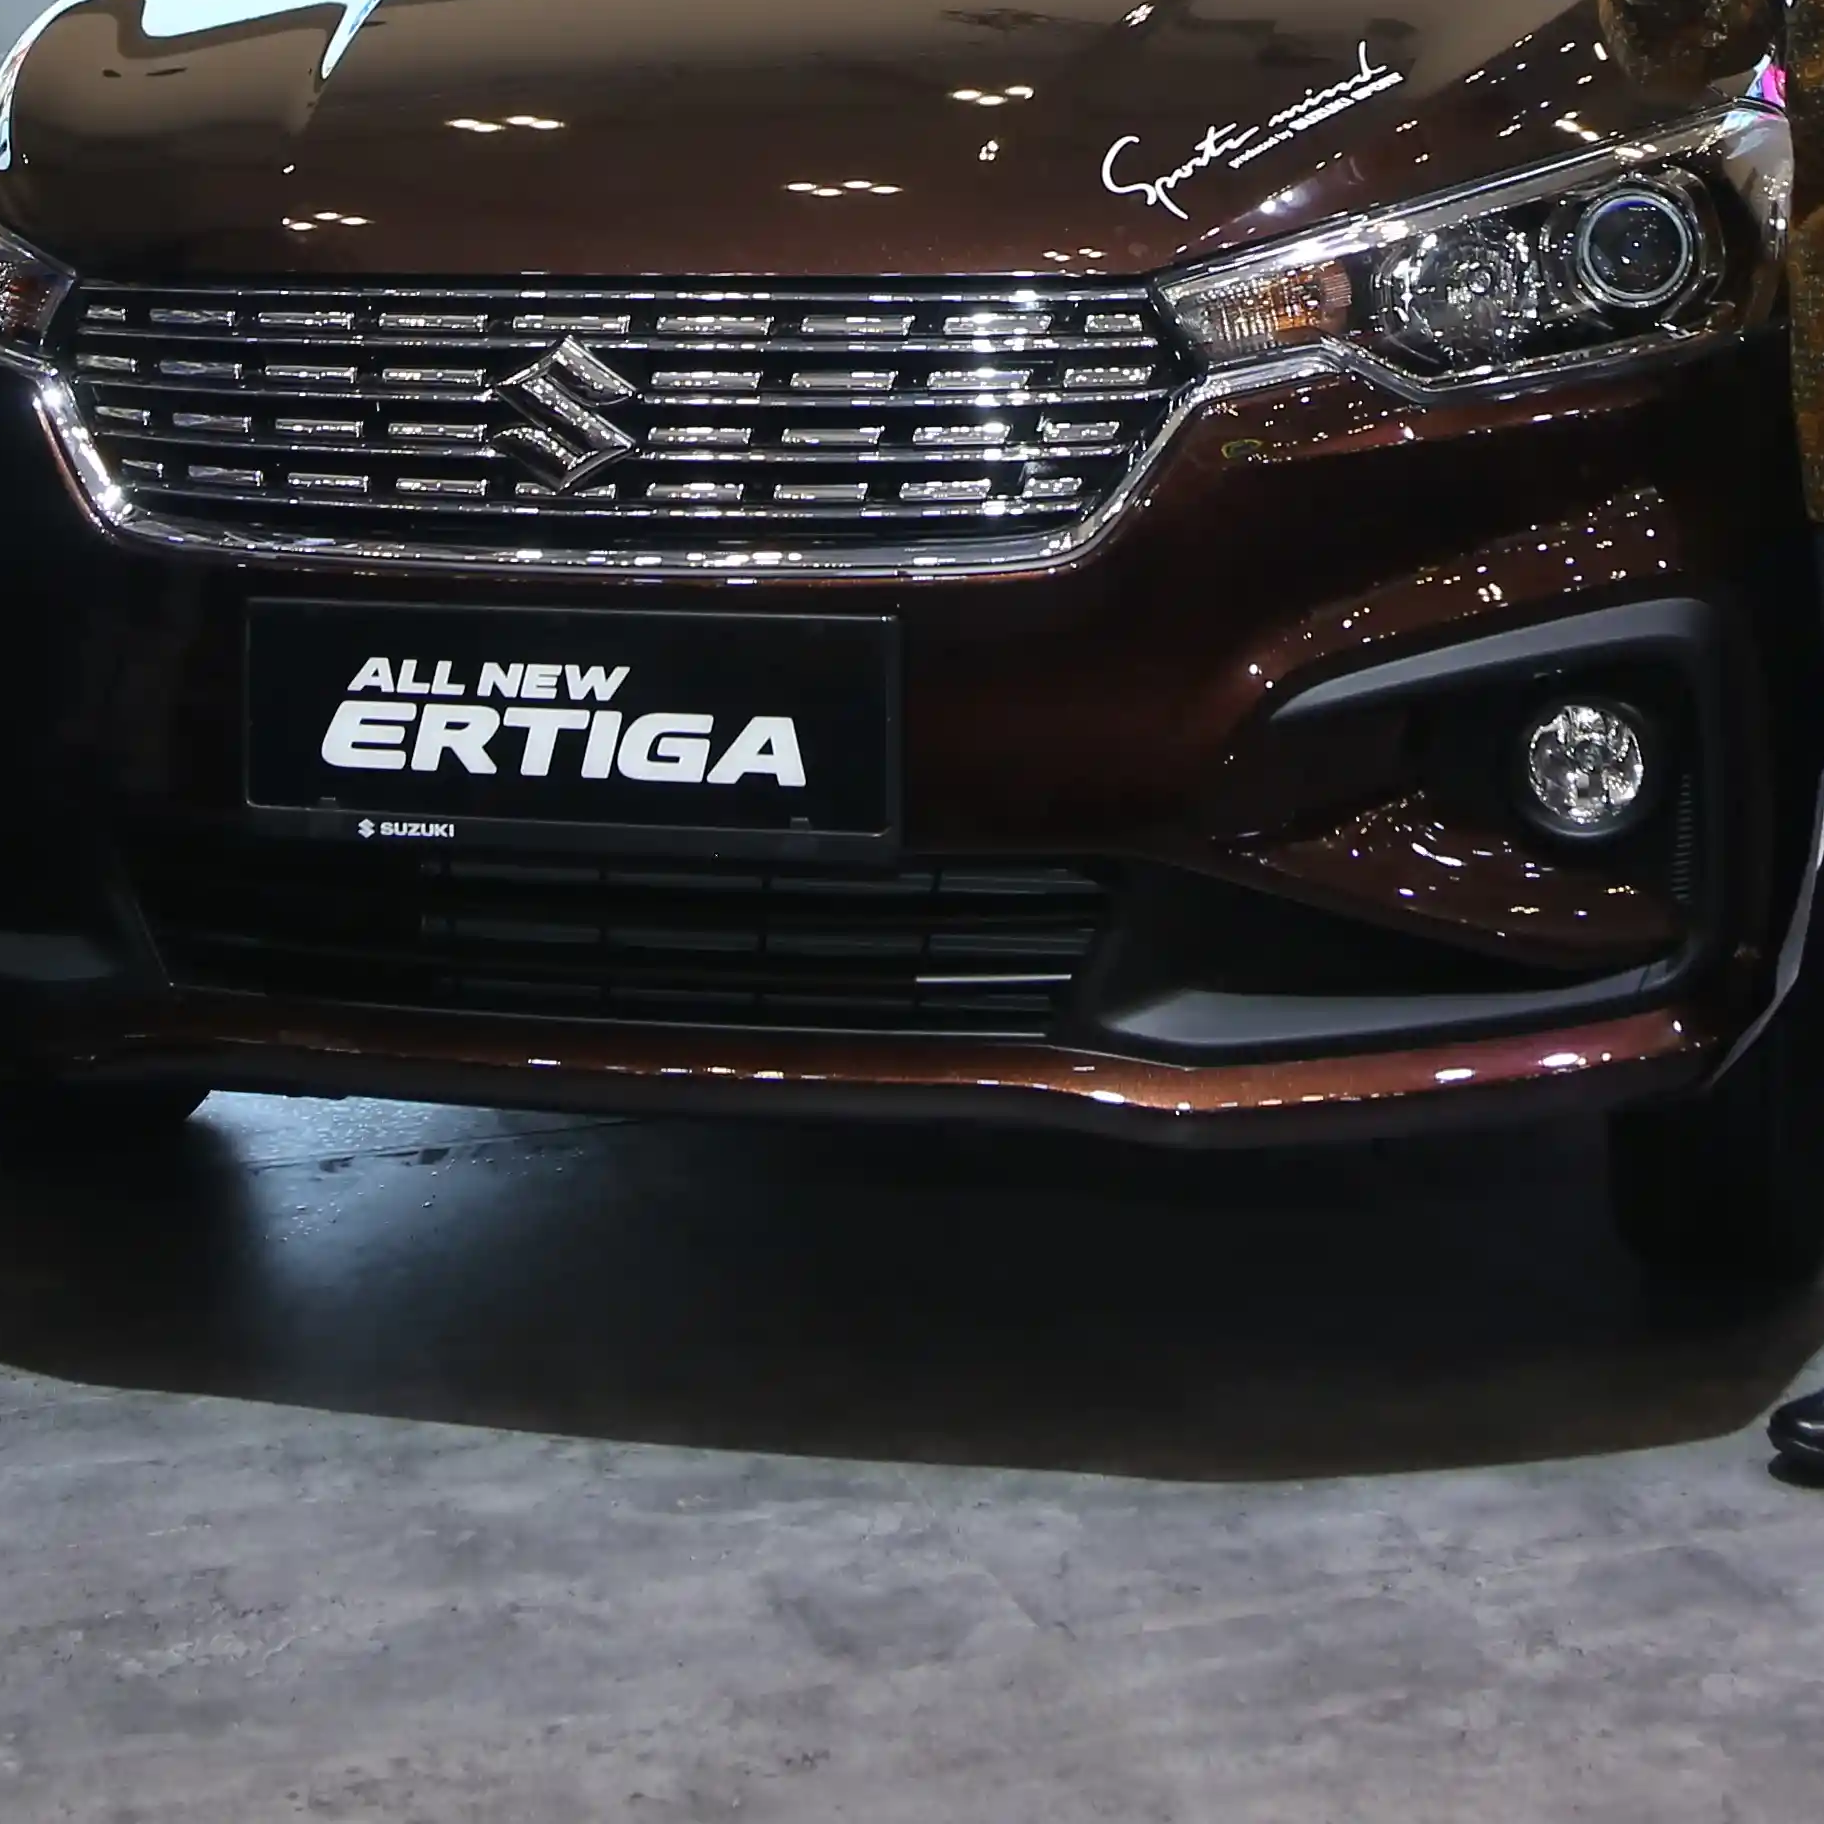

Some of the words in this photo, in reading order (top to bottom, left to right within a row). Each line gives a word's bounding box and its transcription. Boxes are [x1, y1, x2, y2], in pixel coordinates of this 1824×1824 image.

[347, 656, 466, 695] ALL
[476, 661, 631, 702] NEW
[320, 699, 807, 788] ERTIGA
[379, 820, 456, 839] SUZUKI
